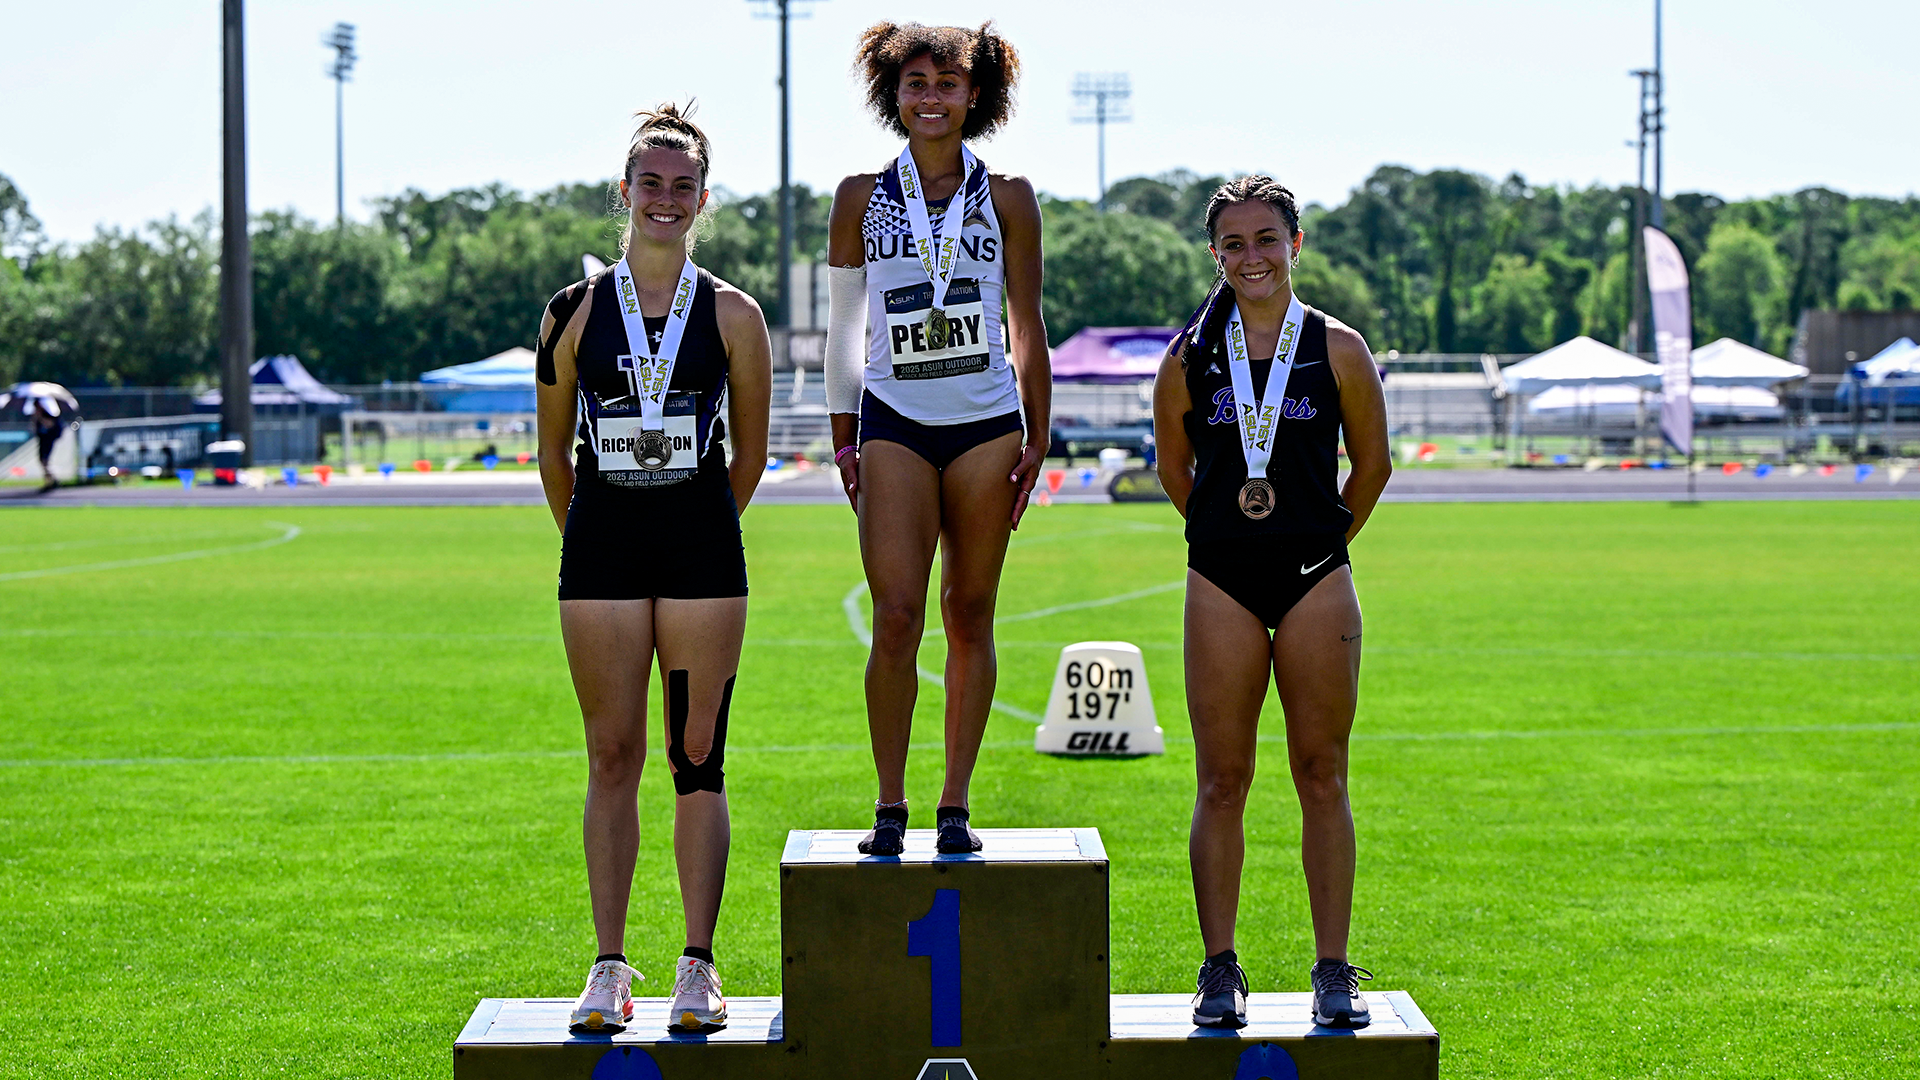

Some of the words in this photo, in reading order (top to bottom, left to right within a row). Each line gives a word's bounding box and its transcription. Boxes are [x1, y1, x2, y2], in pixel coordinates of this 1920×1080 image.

[899, 163, 917, 199] ASUN
[939, 237, 955, 283] ASUN
[620, 276, 638, 314] ASUN
[673, 277, 692, 320] ASUN
[888, 294, 915, 305] ASUN
[891, 314, 981, 355] PERY
[1230, 321, 1246, 362] ASUN
[1277, 321, 1297, 365] ASUN
[638, 355, 652, 393] ASU
[650, 358, 669, 405] ASUN
[900, 364, 920, 374] 2025
[922, 361, 944, 373] ASUN
[945, 356, 982, 369] OUTDOOR
[601, 403, 629, 411] ASUN
[601, 435, 692, 453] RICHON
[1256, 405, 1275, 453] ASUN
[606, 472, 627, 482] 2025
[628, 471, 650, 481] ASUN
[652, 470, 689, 480] OUTDOOR
[1066, 662, 1133, 689] 60m
[1067, 692, 1130, 720] 197'
[1066, 732, 1130, 751] GILL
[907, 888, 962, 1047] 1
